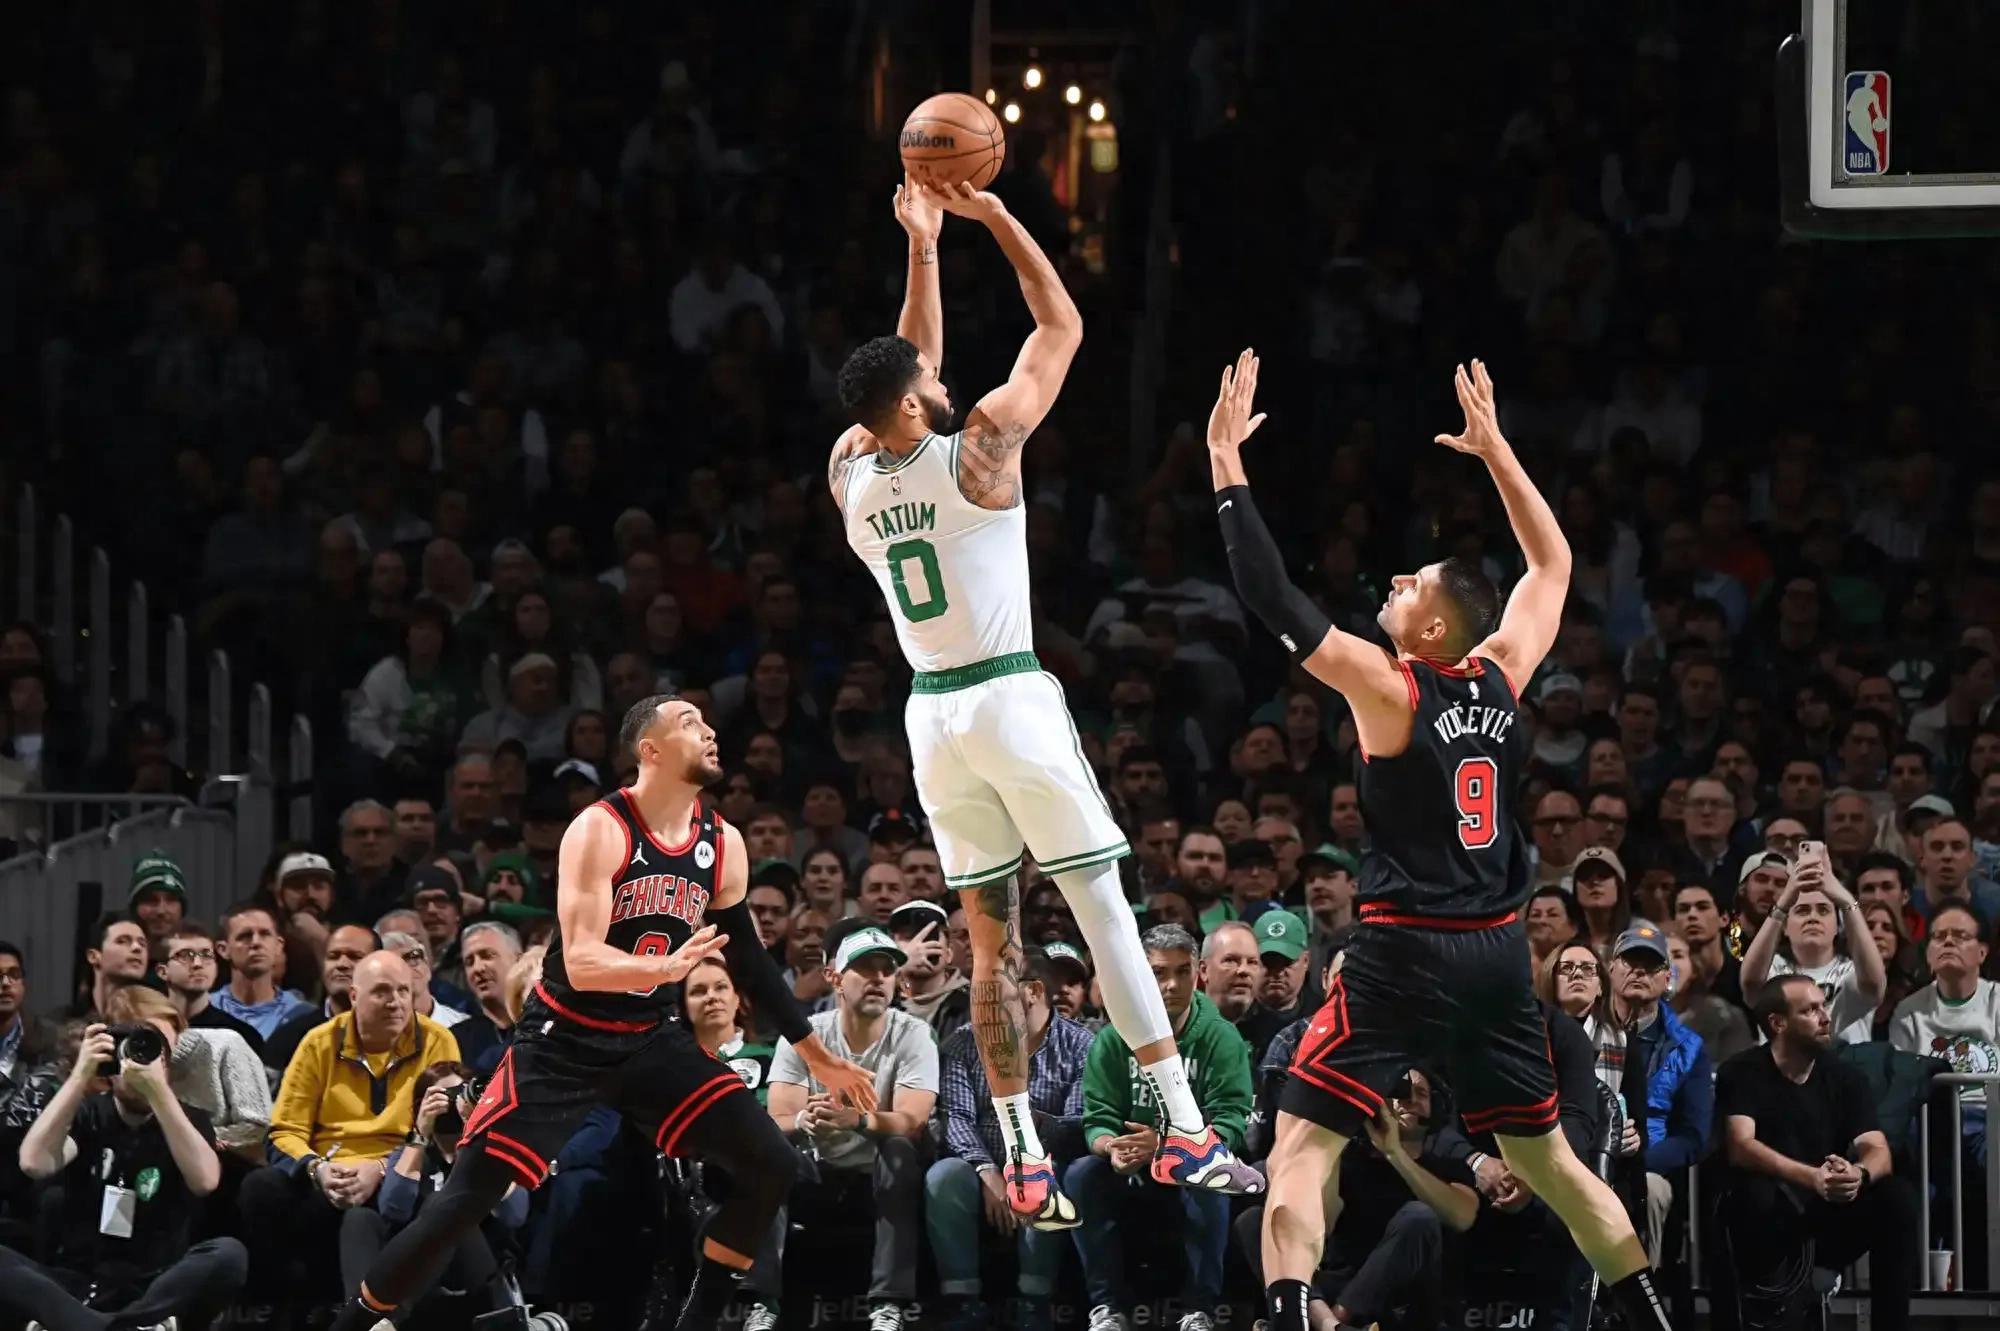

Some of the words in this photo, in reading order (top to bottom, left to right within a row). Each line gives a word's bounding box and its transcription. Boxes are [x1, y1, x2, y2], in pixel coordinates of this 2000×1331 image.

[900, 129, 955, 149] Wilson
[1849, 152, 1872, 168] NBA
[865, 501, 936, 540] TATUM
[886, 538, 949, 623] 0
[1433, 701, 1514, 744] VUČEVIĆ
[1455, 757, 1498, 850] 9
